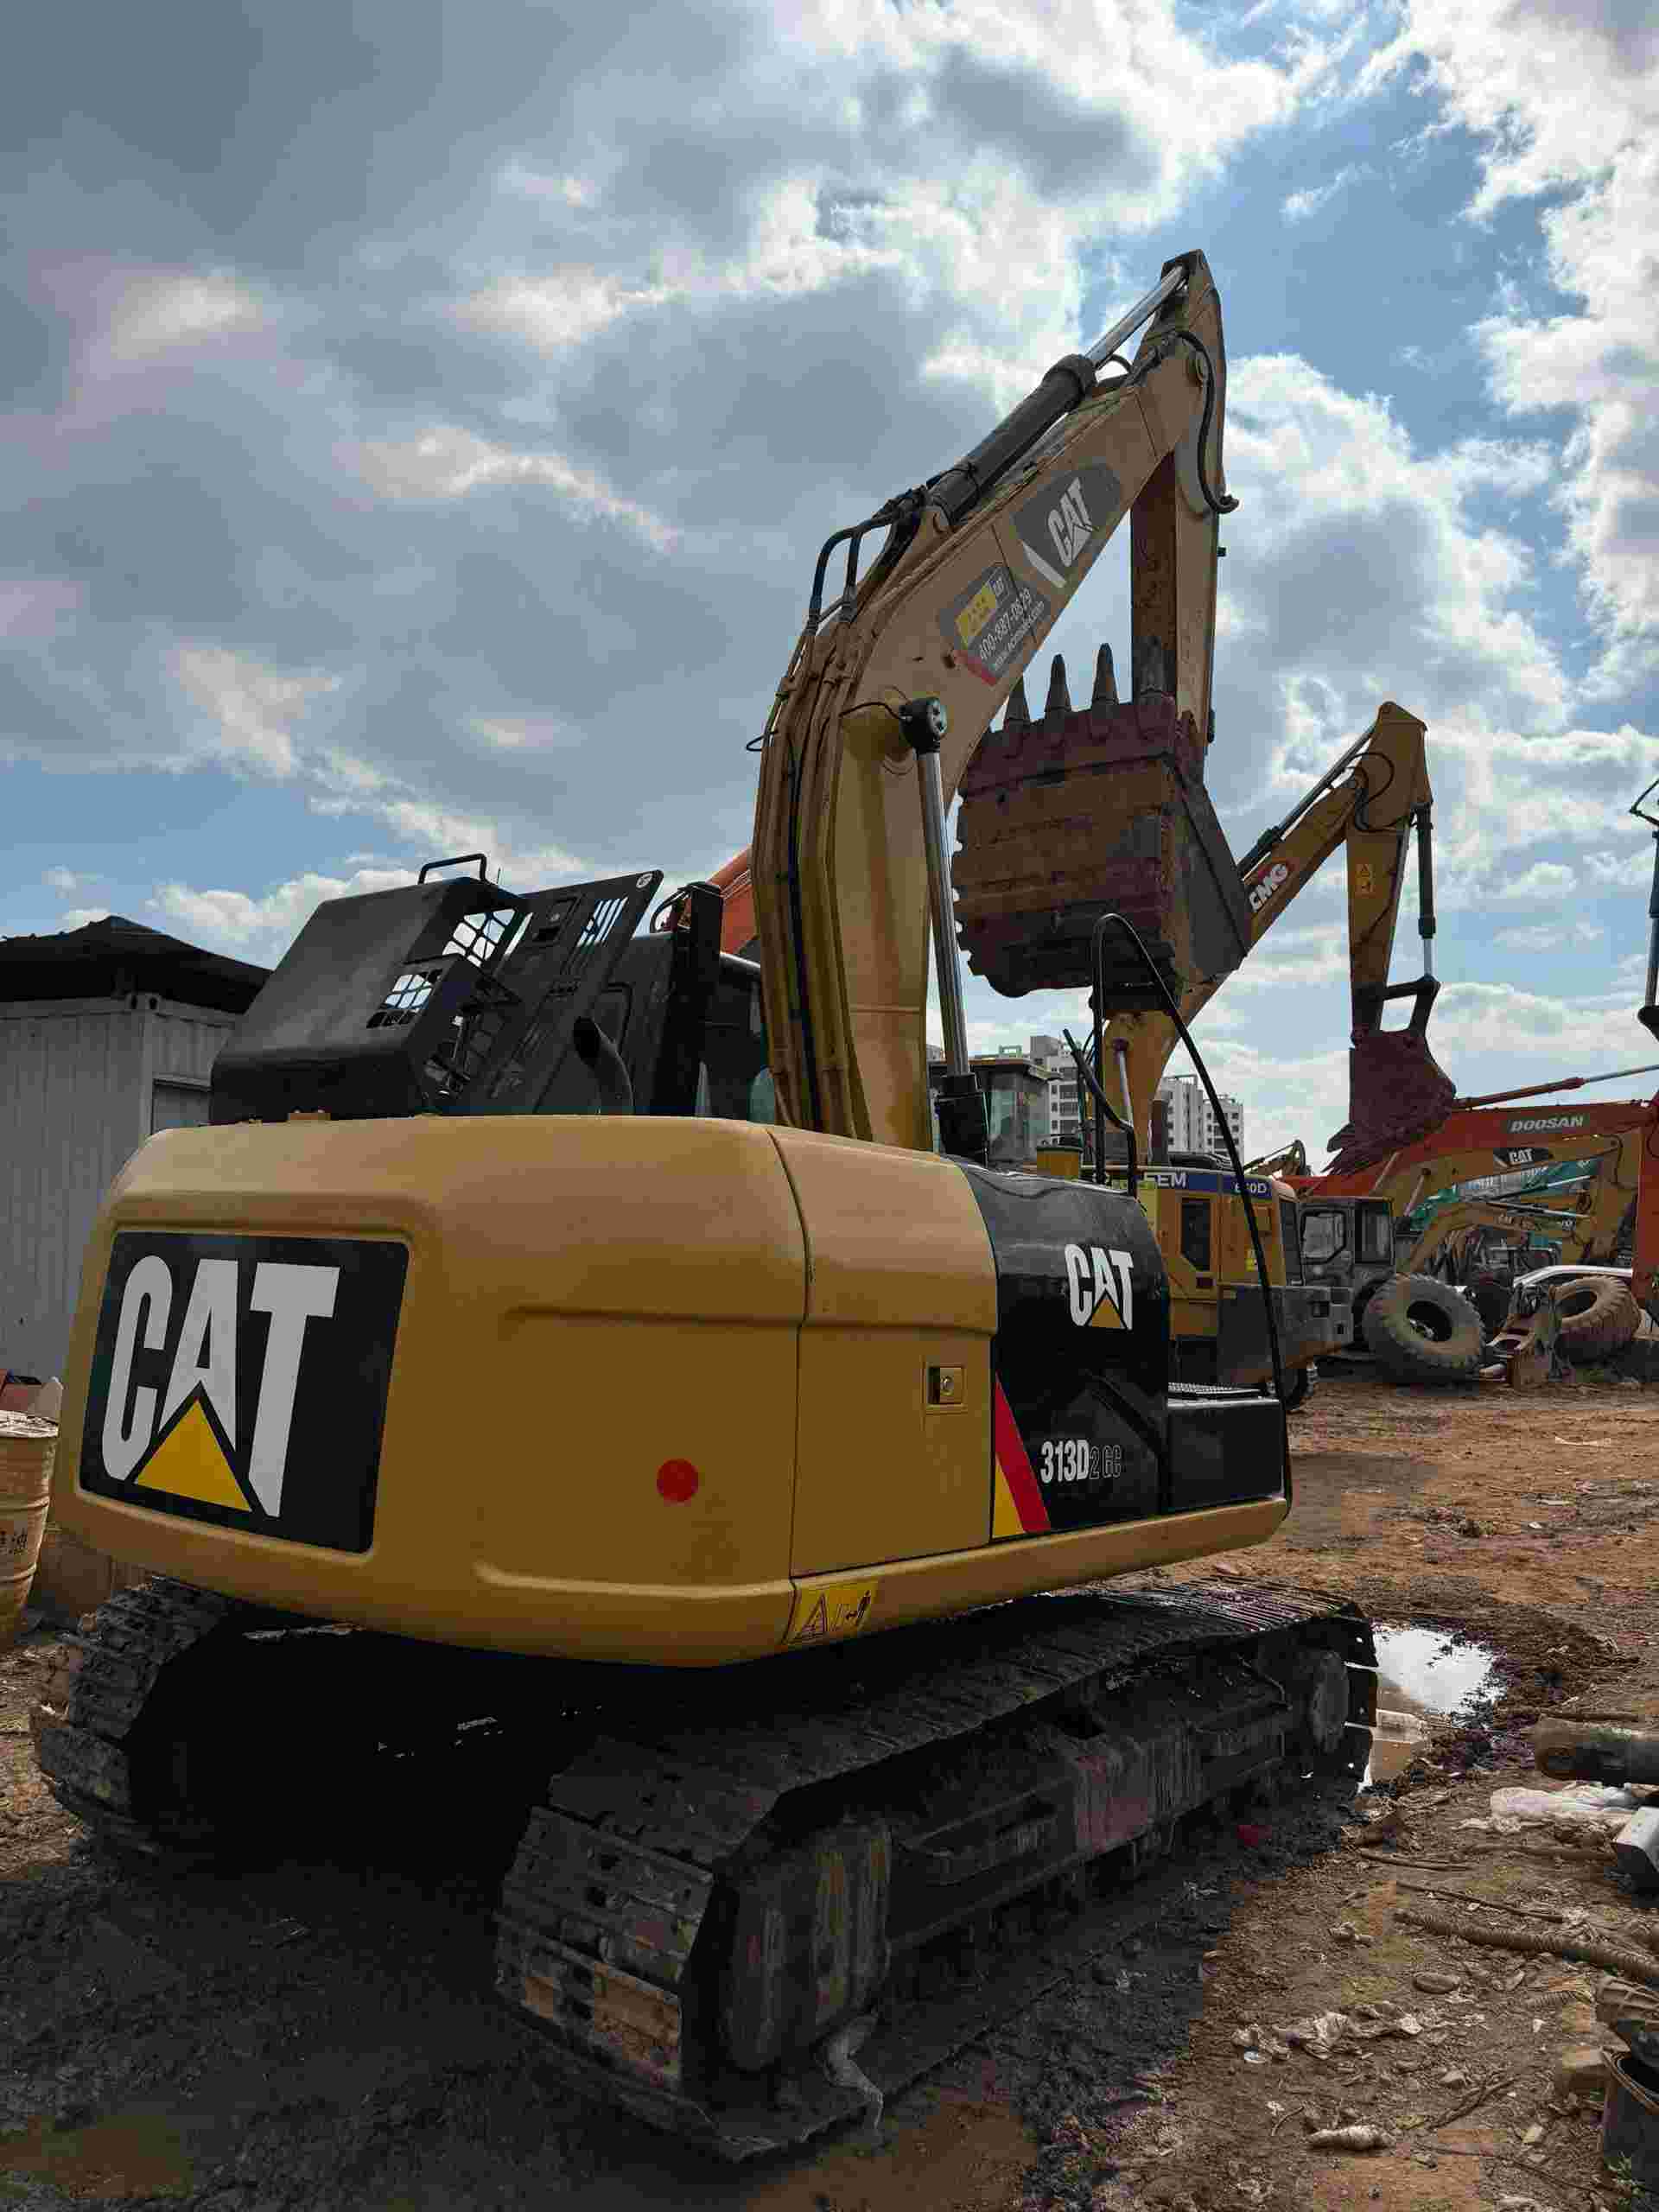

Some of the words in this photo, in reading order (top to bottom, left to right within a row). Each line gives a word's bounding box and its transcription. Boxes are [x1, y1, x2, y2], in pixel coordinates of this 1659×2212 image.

[1047, 476, 1095, 567] CAT
[1509, 1148, 1534, 1163] CAT
[1510, 1115, 1585, 1134] DOOSAN
[1065, 1244, 1134, 1331] CAT
[102, 1255, 340, 1517] CAT
